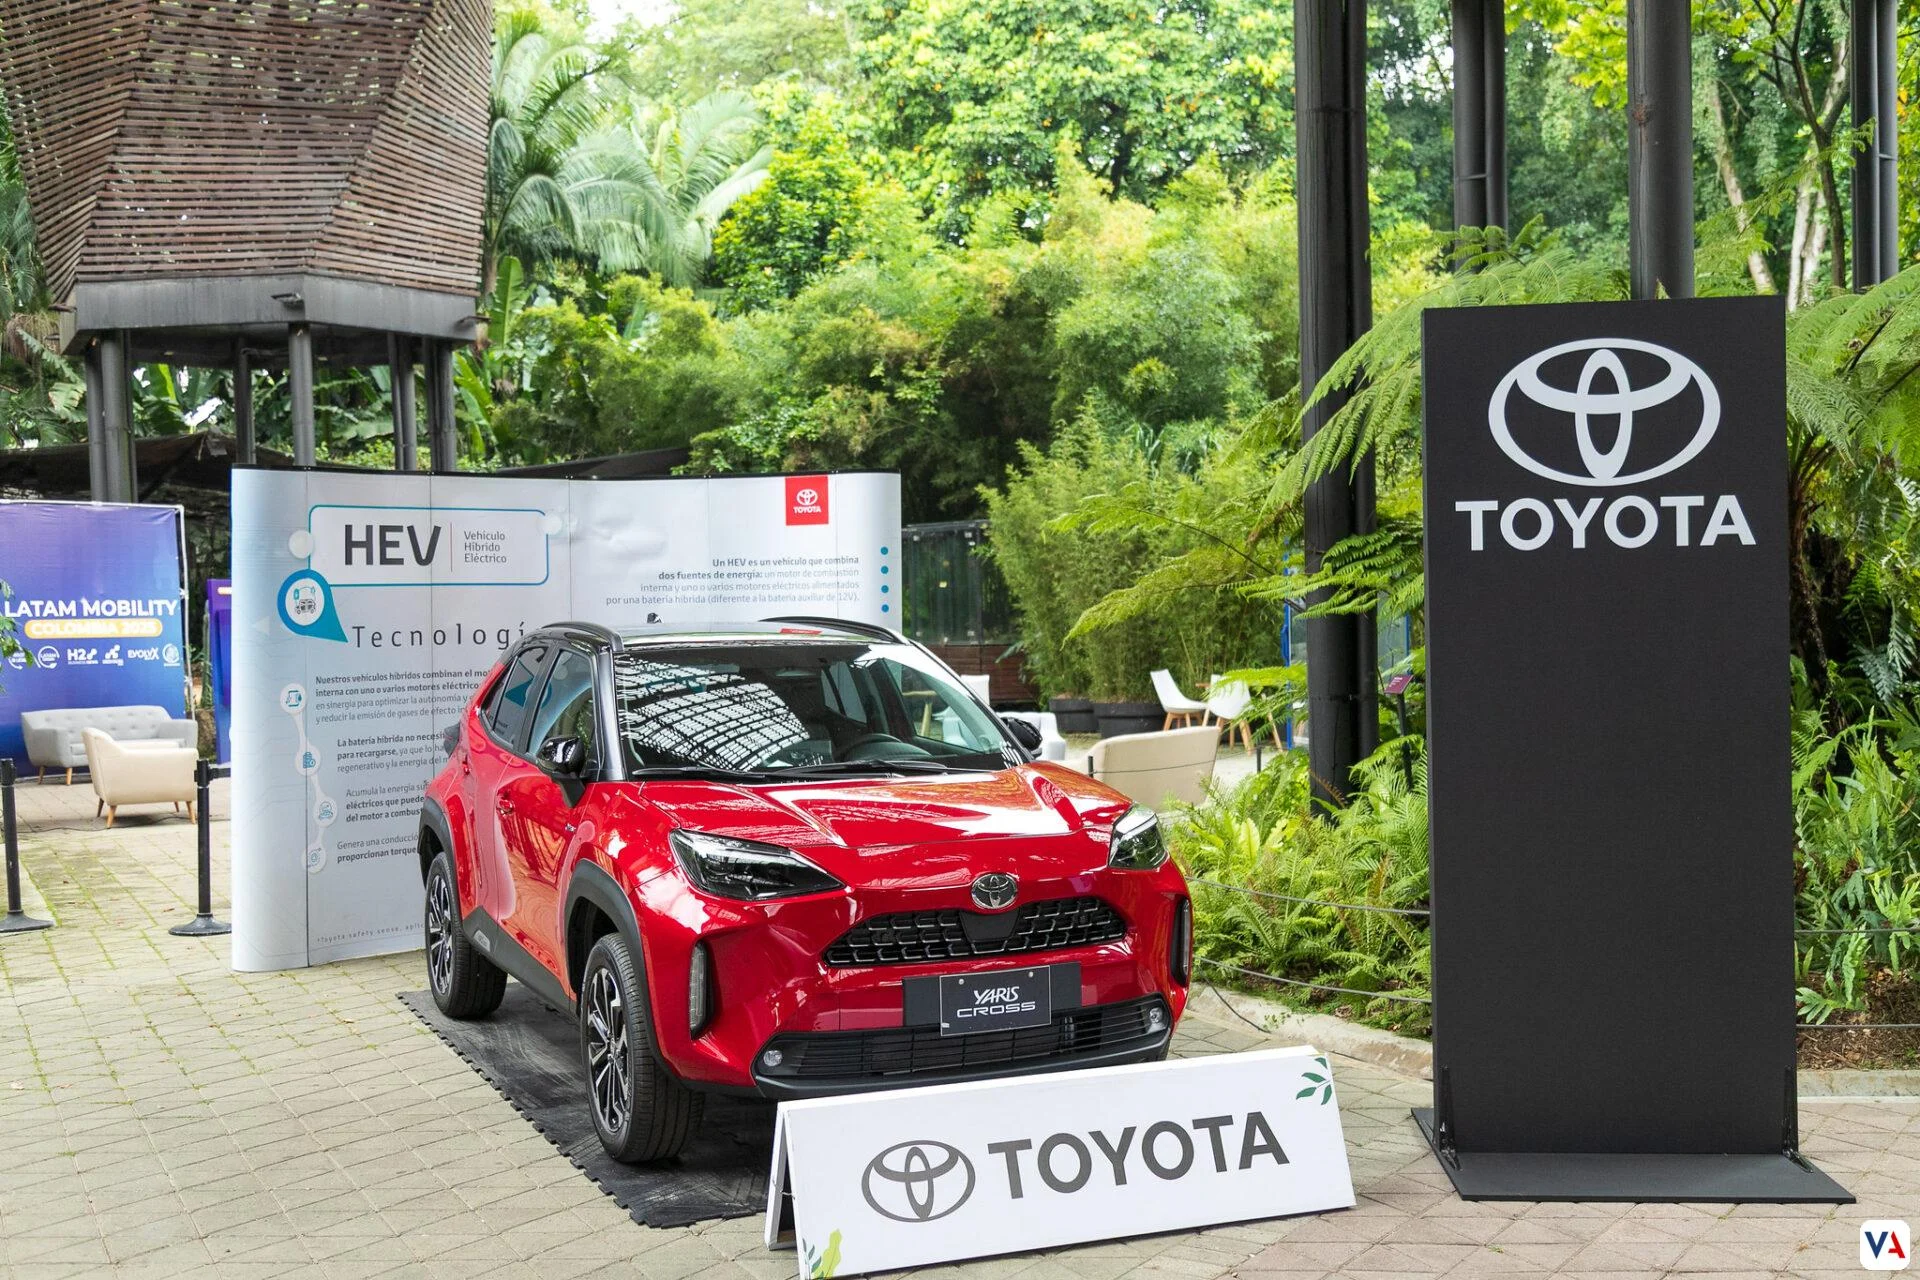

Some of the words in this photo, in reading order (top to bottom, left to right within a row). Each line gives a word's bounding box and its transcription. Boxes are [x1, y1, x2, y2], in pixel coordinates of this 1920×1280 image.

[793, 506, 822, 514] TOYOTA
[1455, 495, 1757, 552] TOYOTA
[464, 530, 506, 541] Vehículo
[345, 524, 442, 567] HEV
[464, 542, 501, 552] Híbrido
[464, 552, 507, 563] Eléctrico
[712, 558, 726, 567] Un
[727, 558, 747, 567] HEV
[760, 559, 770, 567] un
[772, 557, 807, 566] vehículo
[808, 558, 823, 567] que
[824, 555, 860, 565] combina
[658, 571, 675, 580] dos
[677, 570, 712, 580] fuentes
[713, 570, 725, 579] de
[726, 570, 763, 581] energía:
[776, 569, 801, 578] motor
[803, 569, 813, 578] de
[814, 568, 860, 577] combustión
[640, 583, 673, 592] interna
[675, 585, 680, 594] y
[707, 582, 734, 592] varios
[735, 582, 771, 591] motores
[772, 580, 810, 590] eléctricos
[606, 597, 621, 607] por
[623, 597, 640, 605] una
[641, 595, 673, 605] batería
[675, 594, 706, 604] híbrida
[707, 593, 750, 605] (diferente
[759, 593, 767, 602] la
[826, 590, 836, 600] de
[4, 600, 77, 618] LATAM
[80, 598, 178, 617] MOBILITY
[31, 621, 118, 635] COLOMBIA
[121, 621, 158, 635] 2025
[315, 675, 351, 685] Nuestros
[352, 672, 388, 682] vehículos
[389, 671, 421, 680] híbridos
[422, 669, 463, 679] combinan
[464, 669, 473, 677] el
[474, 669, 491, 678] mo
[315, 688, 344, 697] interna
[345, 687, 359, 696] con
[360, 687, 375, 695] uno
[383, 685, 406, 693] varios
[407, 682, 441, 692] motores
[442, 680, 481, 691] eléctrico
[315, 703, 326, 711] en
[357, 699, 374, 710] para
[375, 696, 409, 708] optimizar
[410, 695, 418, 704] la
[418, 692, 461, 704] autonomía
[321, 713, 347, 723] reducir
[348, 711, 356, 720] la
[357, 709, 386, 720] emisión
[386, 709, 396, 718] de
[397, 707, 418, 719] gases
[420, 707, 430, 716] de
[431, 704, 456, 715] efecto
[337, 738, 347, 748] La
[347, 736, 376, 747] batería
[376, 733, 404, 744] híbrida
[405, 734, 415, 742] no
[337, 751, 355, 762] para
[356, 748, 398, 758] recargarse,
[399, 748, 408, 757] ya
[409, 746, 424, 755] que
[425, 744, 433, 753] lo
[337, 761, 385, 774] regenerativo
[391, 759, 398, 768] la
[399, 757, 428, 768] energía
[428, 755, 441, 765] del
[346, 787, 378, 798] Acumula
[379, 786, 386, 794] la
[387, 782, 415, 793] energía
[346, 799, 383, 810] eléctricos
[385, 798, 399, 808] que
[400, 795, 425, 805] puede
[346, 812, 359, 823] del
[359, 811, 383, 821] motor
[337, 840, 365, 850] Genera
[366, 838, 380, 846] una
[337, 849, 389, 864] proporcionan
[390, 846, 417, 857] torque
[973, 985, 1020, 1005] YARIS
[956, 1000, 1036, 1018] CROSS
[987, 1110, 1290, 1199] TOYOTA
